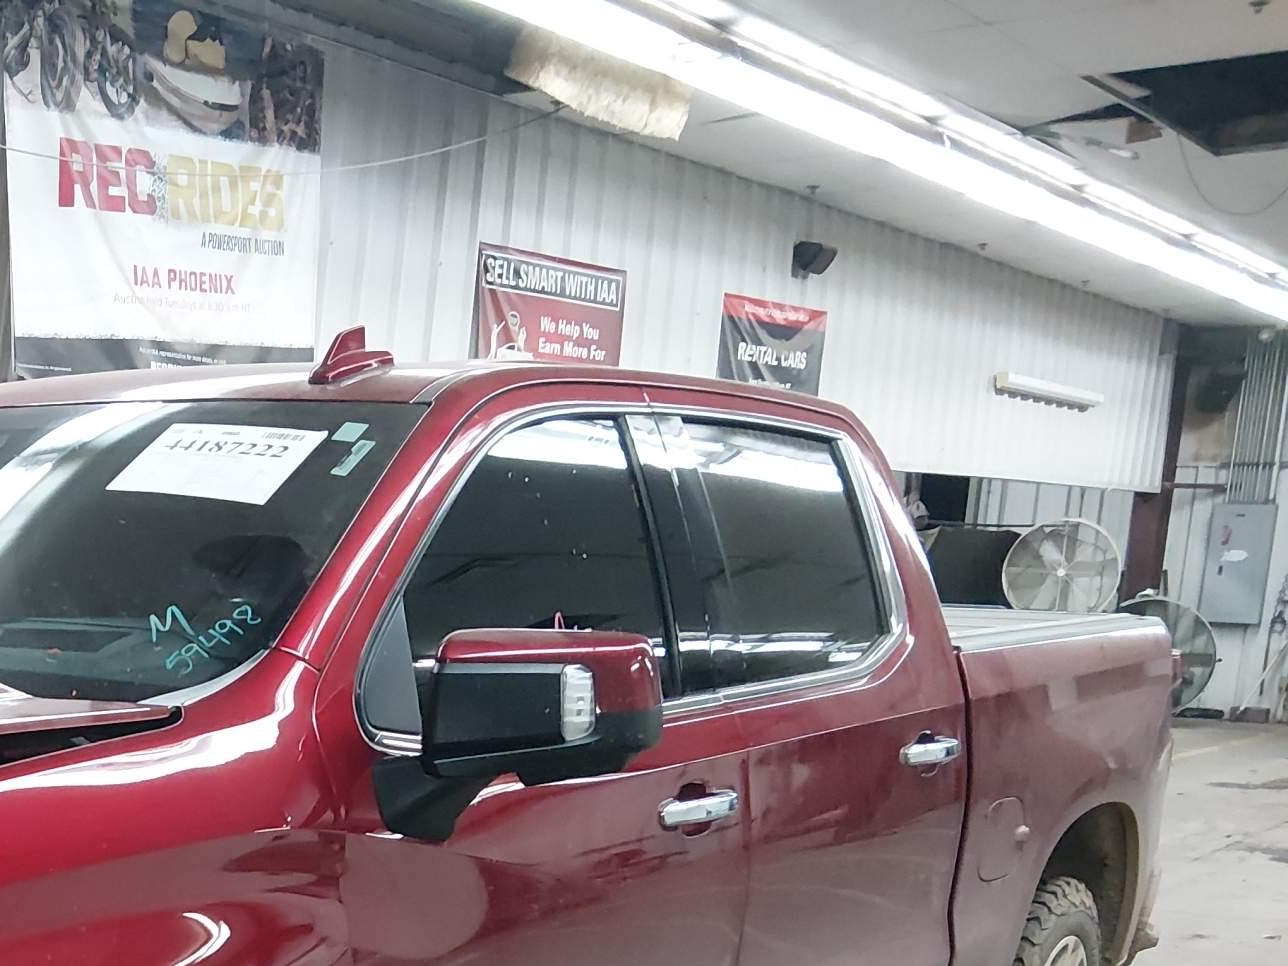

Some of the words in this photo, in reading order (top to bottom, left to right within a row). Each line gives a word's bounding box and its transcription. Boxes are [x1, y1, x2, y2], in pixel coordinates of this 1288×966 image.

[58, 137, 158, 216] REC
[168, 154, 285, 232] RIDES
[201, 232, 206, 248] A
[208, 232, 252, 254] POWERSPORT
[254, 238, 285, 256] AUCTION
[133, 264, 162, 289] IAA
[167, 268, 236, 295] PHOENIX
[486, 257, 516, 287] SELL
[518, 263, 563, 295] SMART
[565, 272, 595, 300] WITH
[597, 279, 617, 305] IAA
[540, 316, 556, 334] We
[557, 319, 580, 340] Help
[582, 322, 600, 340] You
[538, 337, 561, 355] Earn
[562, 340, 588, 360] More
[589, 344, 606, 361] For
[737, 341, 778, 366] RENTAL
[780, 350, 807, 370] CARS
[164, 438, 289, 458] 44187222
[149, 604, 195, 643] M
